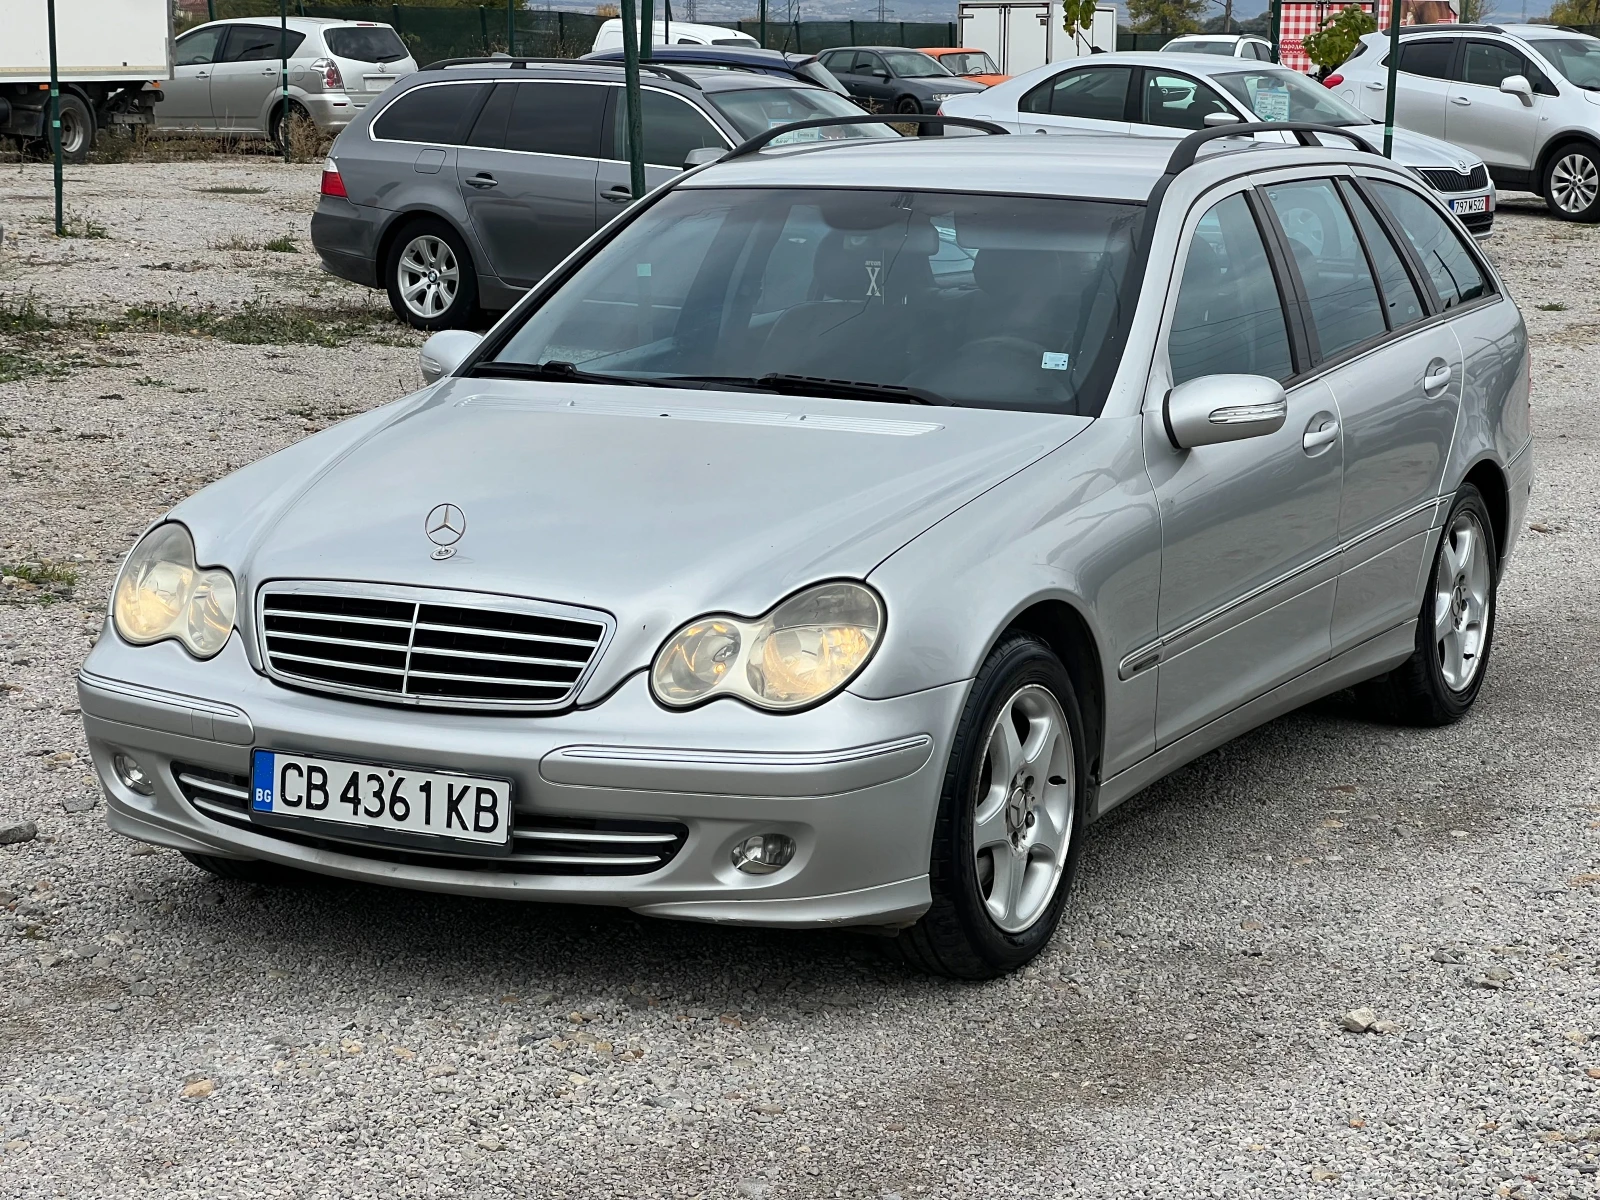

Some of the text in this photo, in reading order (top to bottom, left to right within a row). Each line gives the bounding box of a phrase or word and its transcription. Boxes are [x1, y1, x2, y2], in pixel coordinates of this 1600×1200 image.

[865, 266, 881, 296] X
[255, 788, 272, 803] BG
[280, 762, 499, 834] CB 4361 KB
